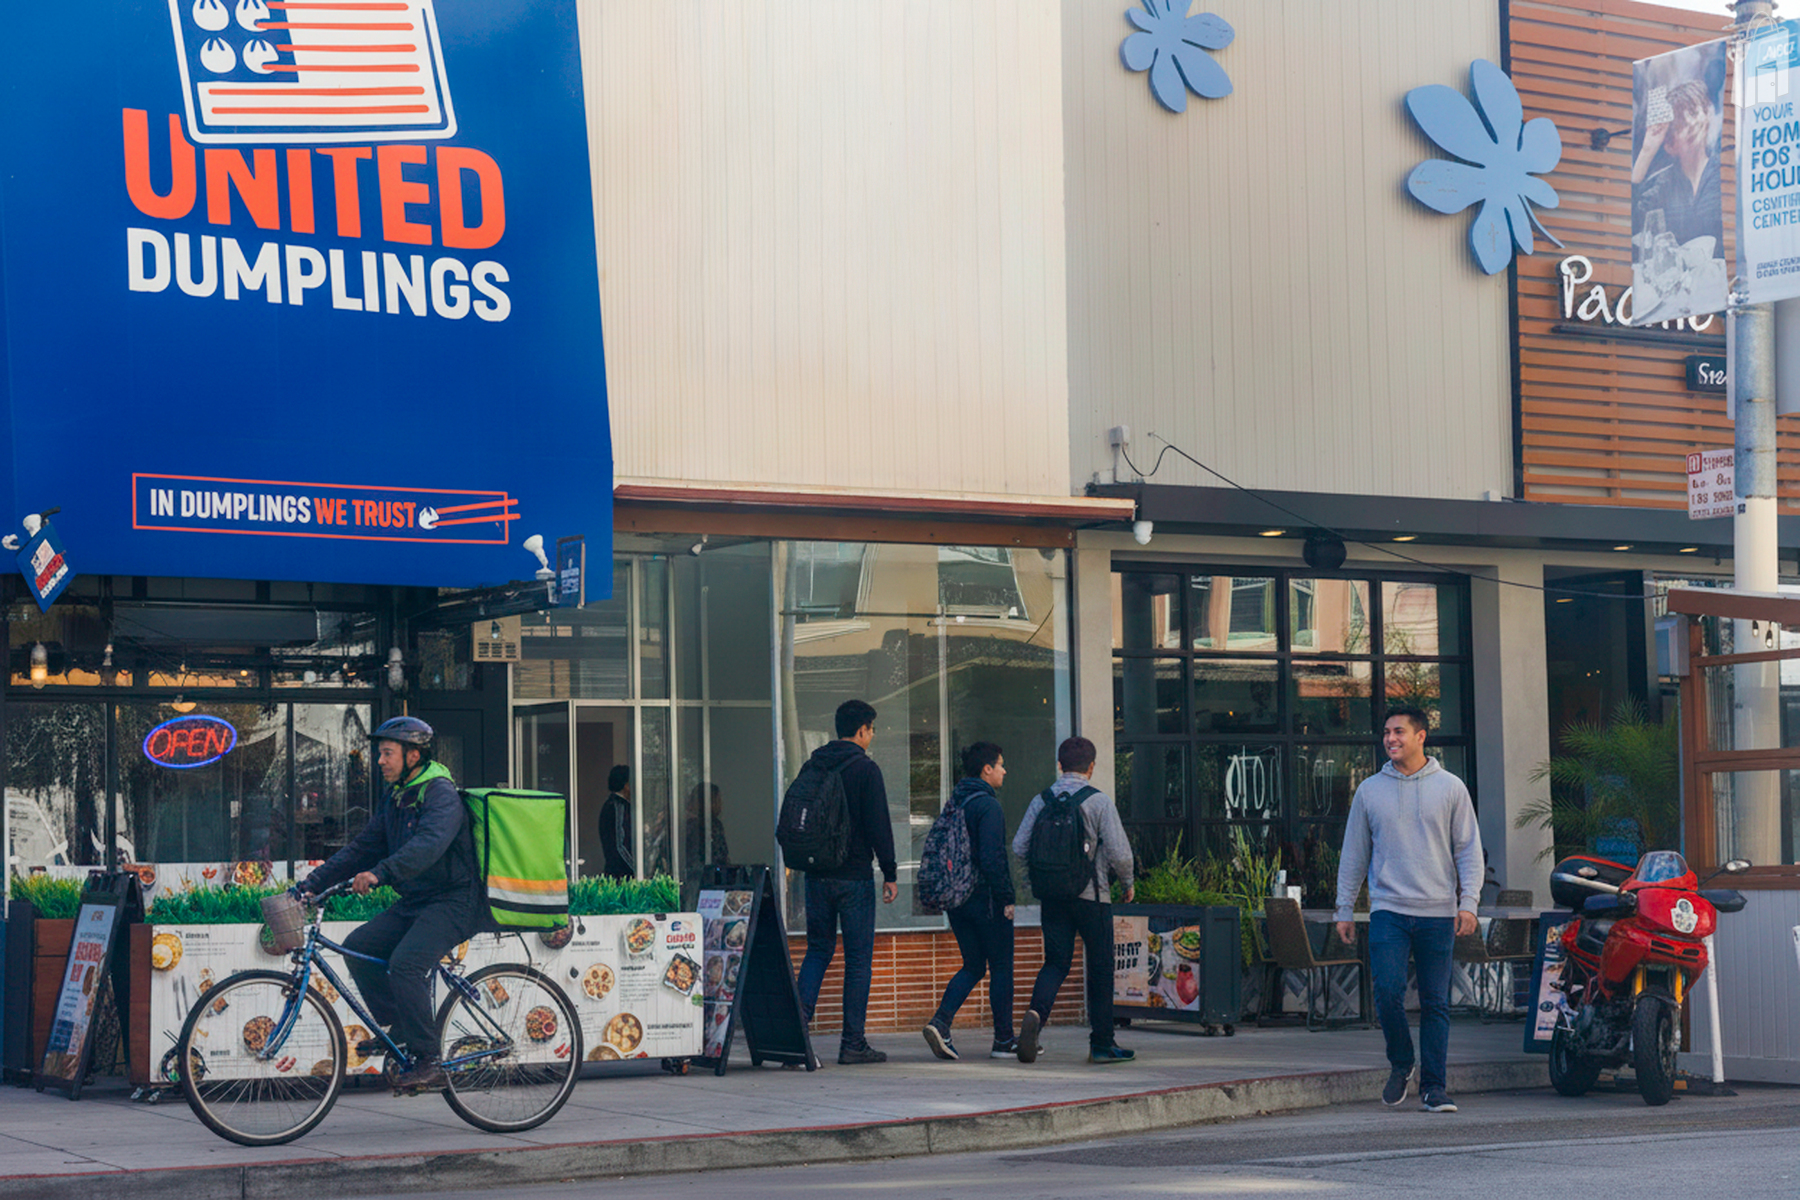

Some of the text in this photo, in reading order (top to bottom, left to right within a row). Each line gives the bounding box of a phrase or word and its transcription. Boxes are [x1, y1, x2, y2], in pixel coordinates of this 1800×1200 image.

[122, 107, 506, 249] UNITED
[126, 227, 512, 322] DUMPLINGS
[150, 488, 417, 528] IN DUMPLINGS WE TRUST
[150, 728, 228, 758] OPEN
